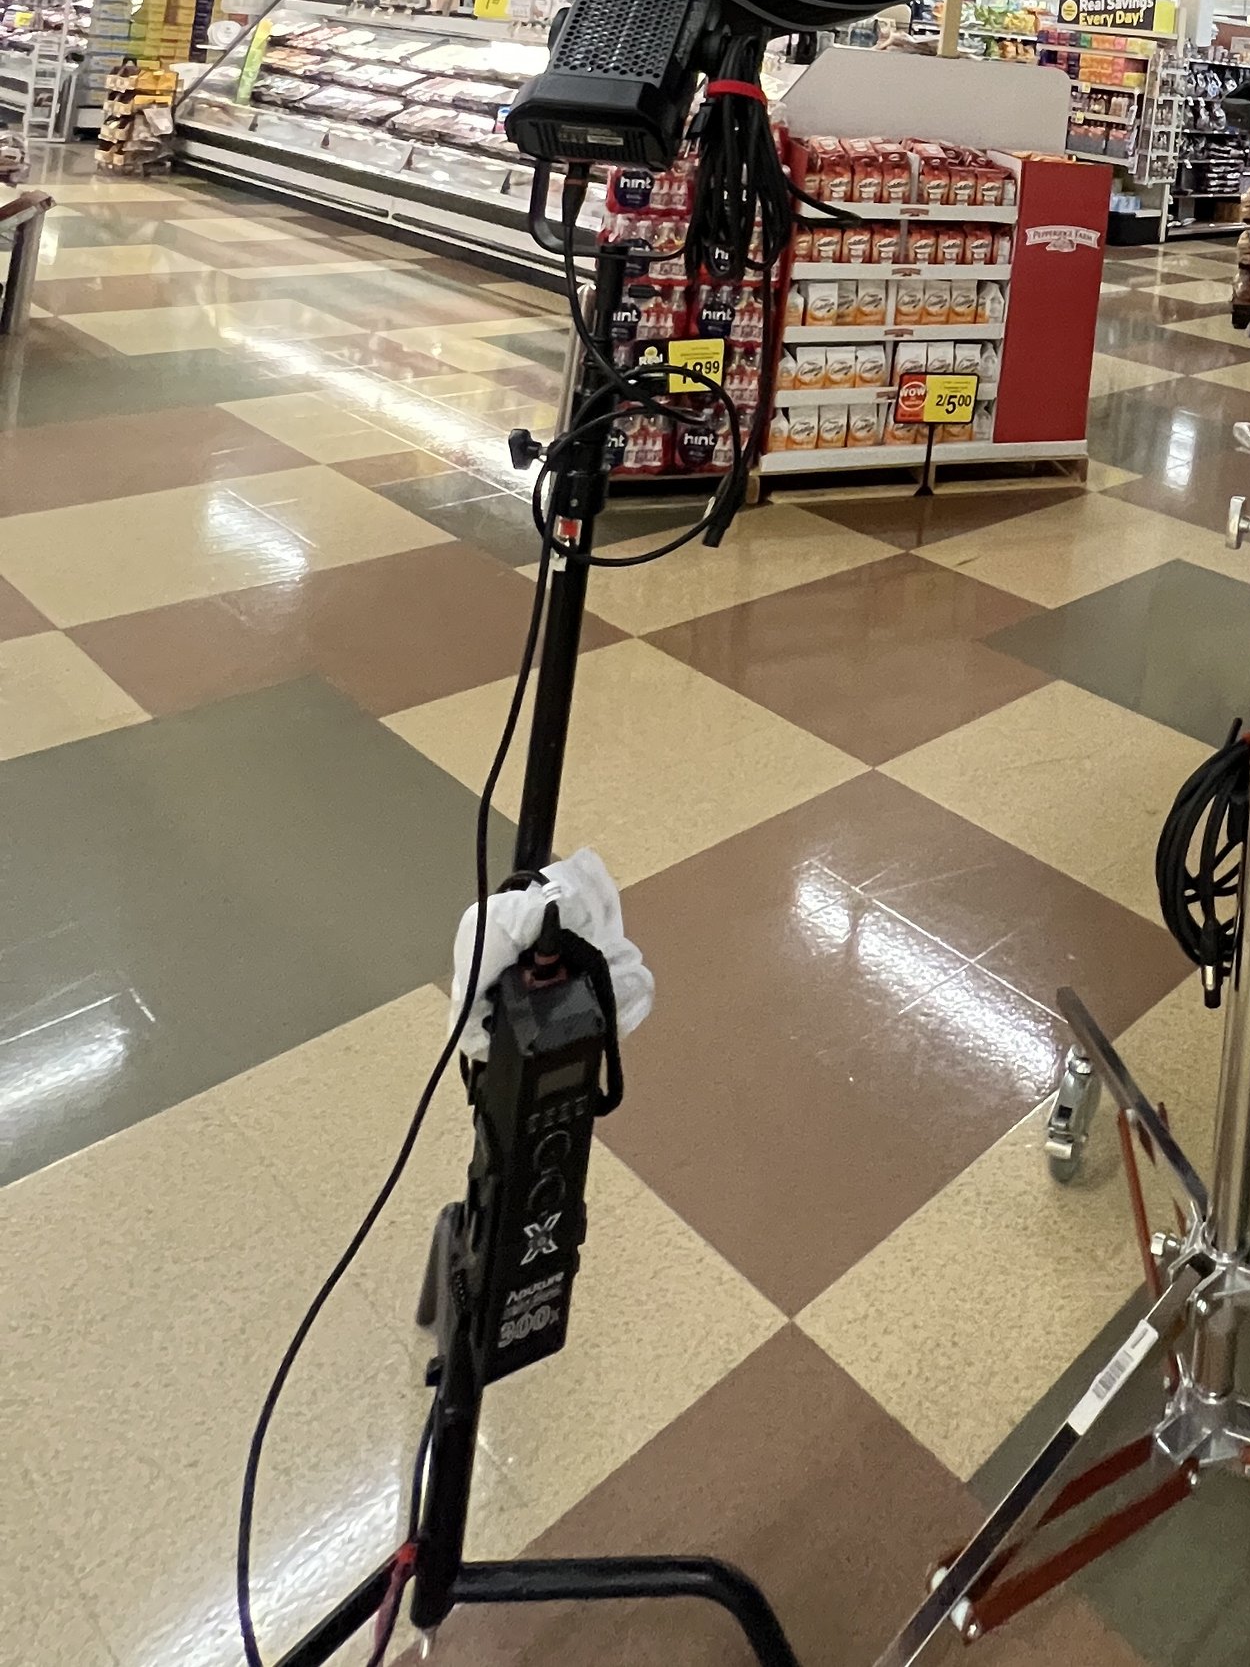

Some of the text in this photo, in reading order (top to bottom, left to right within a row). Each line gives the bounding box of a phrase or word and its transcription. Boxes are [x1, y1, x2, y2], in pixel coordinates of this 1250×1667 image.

[1079, 10, 1145, 28] Every Day!
[619, 175, 653, 190] hint
[701, 308, 734, 321] hint
[900, 387, 926, 398] WOW
[683, 432, 716, 446] hint
